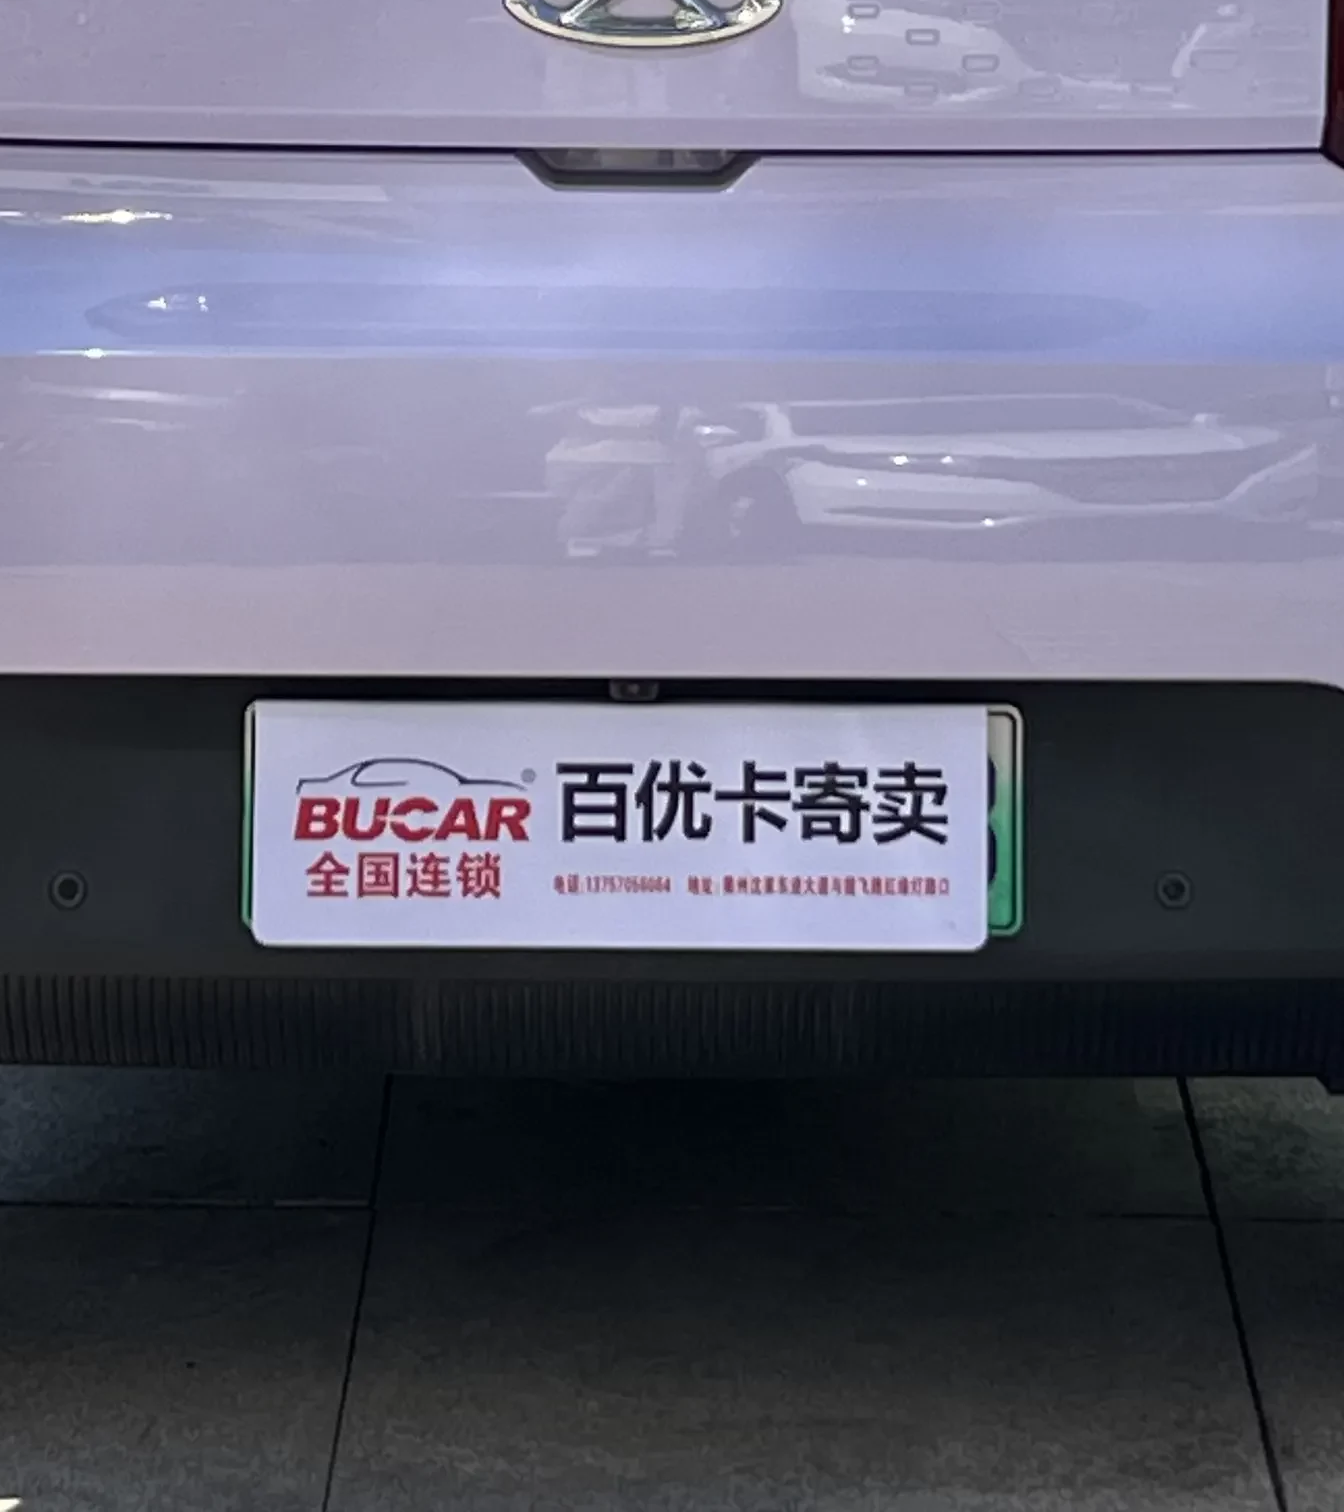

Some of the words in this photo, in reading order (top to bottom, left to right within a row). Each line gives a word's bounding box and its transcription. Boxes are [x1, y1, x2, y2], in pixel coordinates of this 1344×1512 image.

[293, 796, 531, 842] BUCAR
[555, 758, 949, 845] 百优卡寄卖
[305, 851, 502, 900] 全国连锁
